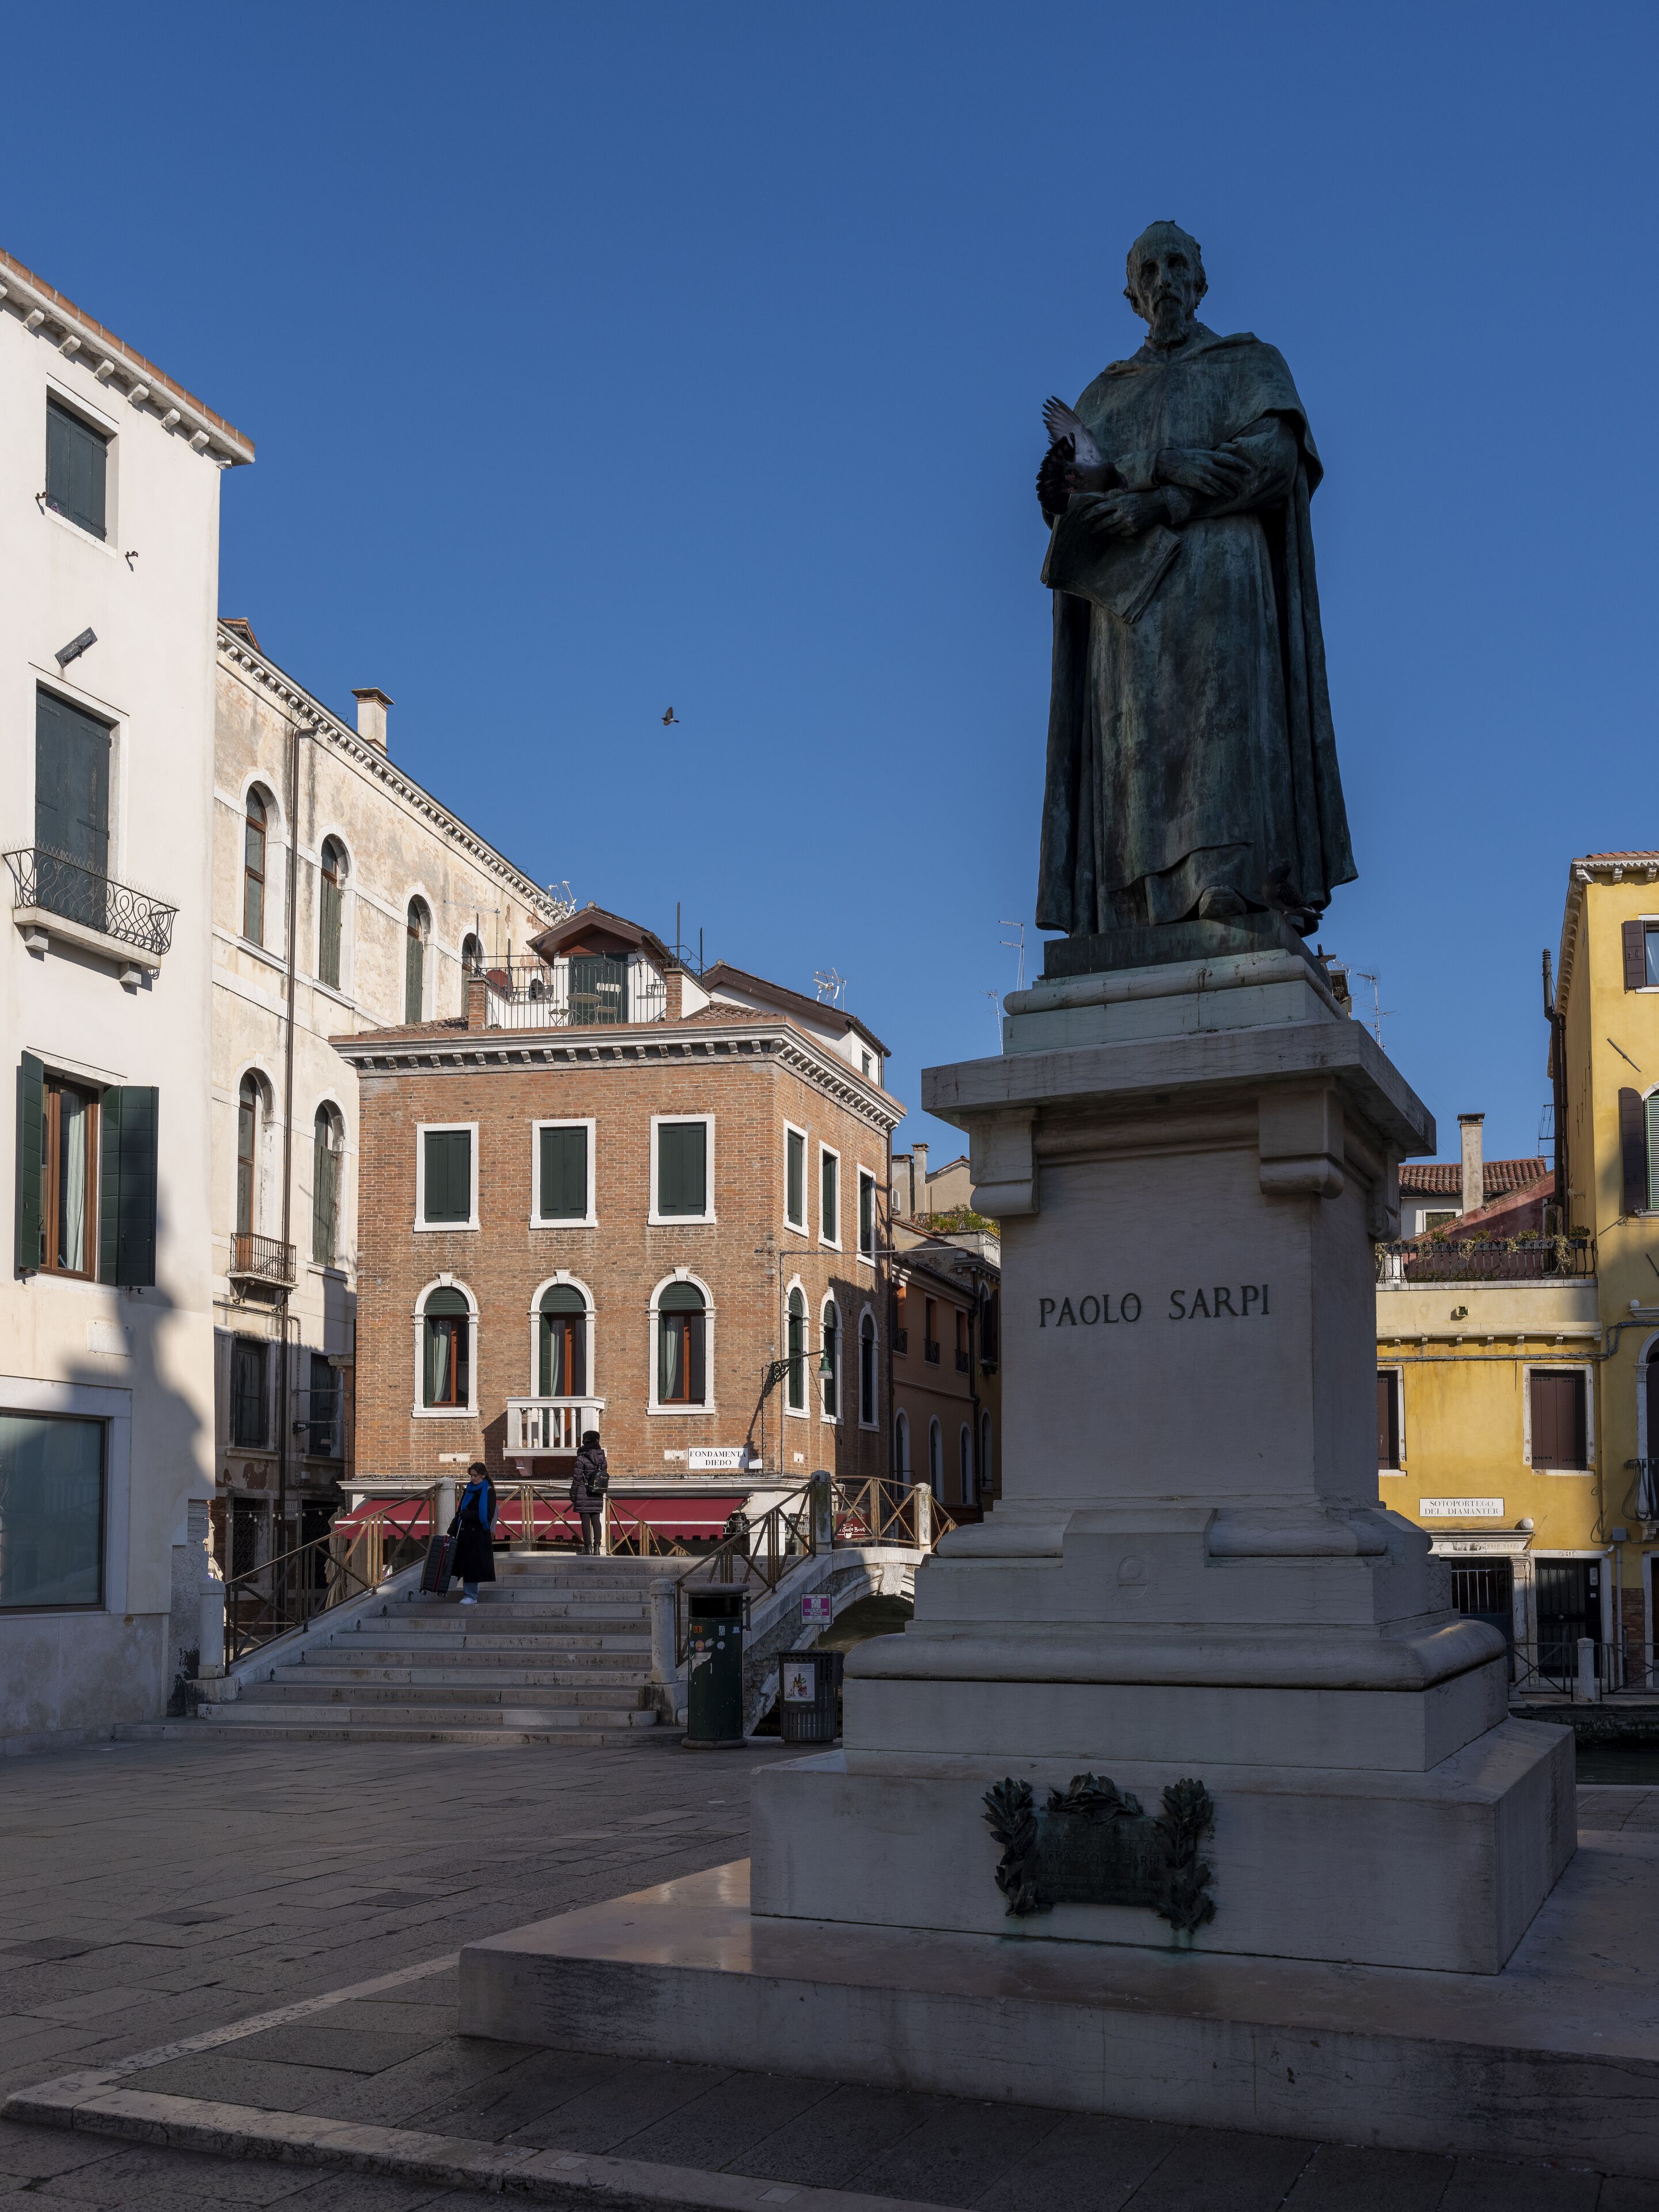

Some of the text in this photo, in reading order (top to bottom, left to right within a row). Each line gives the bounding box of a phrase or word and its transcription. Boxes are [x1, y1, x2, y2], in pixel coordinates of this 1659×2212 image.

[1039, 1285, 1270, 1327] PAOLO SARPI
[1069, 1822, 1121, 1835] VENEZIA
[1047, 1850, 1071, 1861] FRA
[1075, 1851, 1118, 1863] PAOLO
[1123, 1853, 1160, 1866] SARPI
